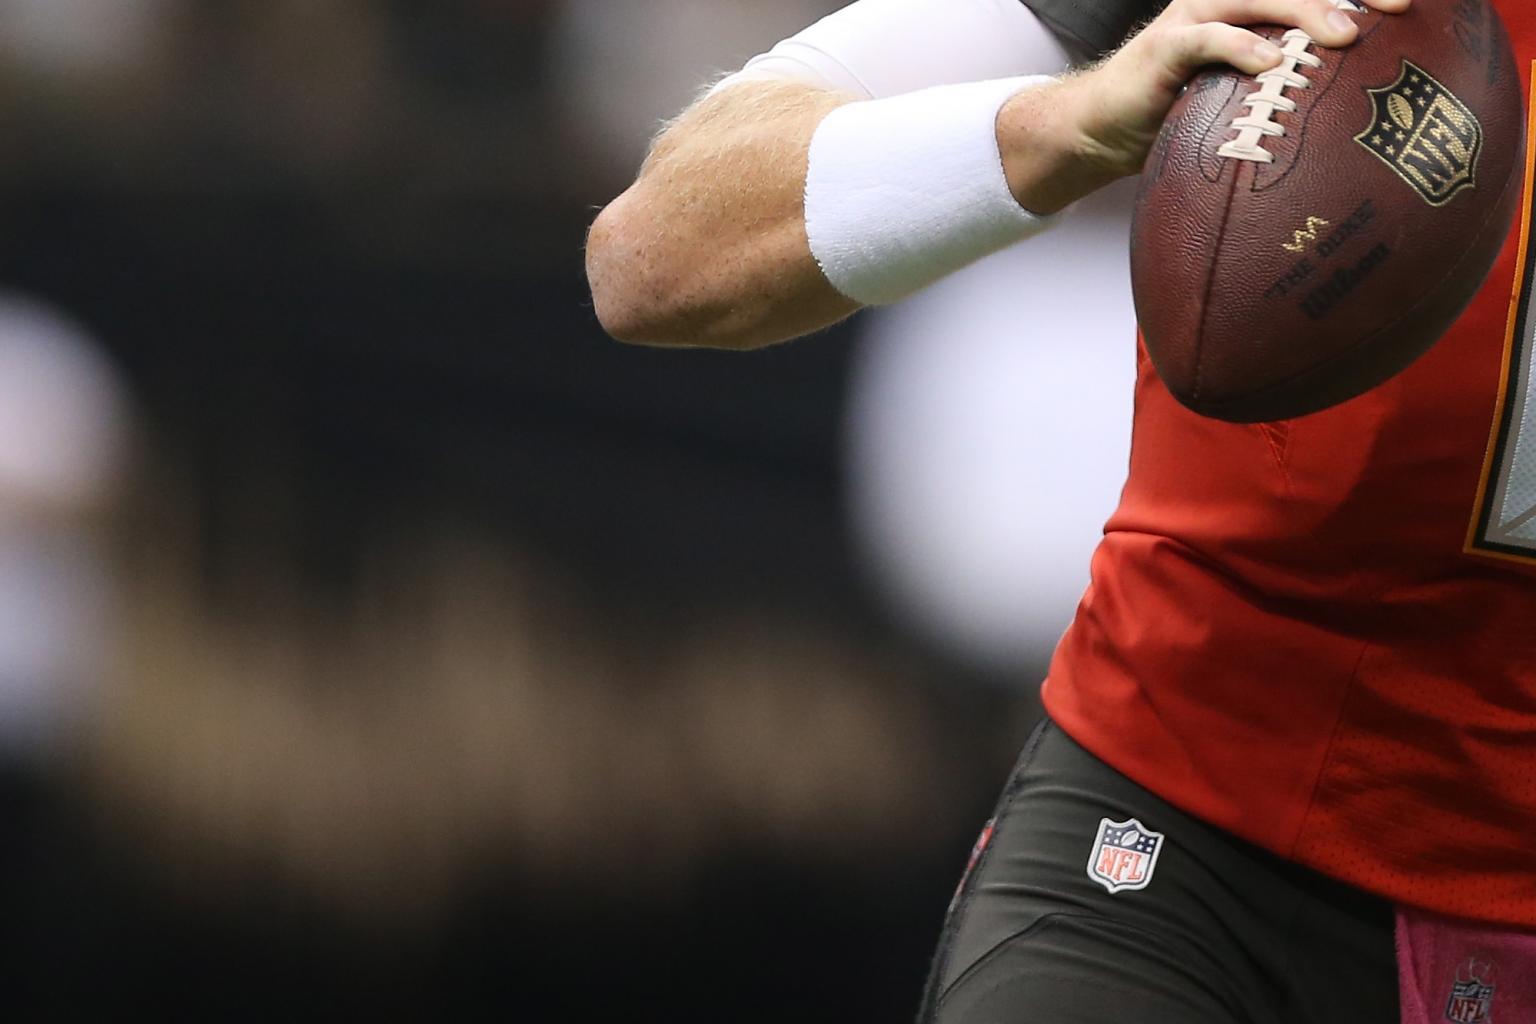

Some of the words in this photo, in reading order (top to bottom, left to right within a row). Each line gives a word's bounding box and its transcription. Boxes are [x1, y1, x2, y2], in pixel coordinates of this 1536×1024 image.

[1400, 102, 1473, 193] NFL
[1097, 845, 1144, 882] NFL
[1449, 997, 1486, 1023] NFL
